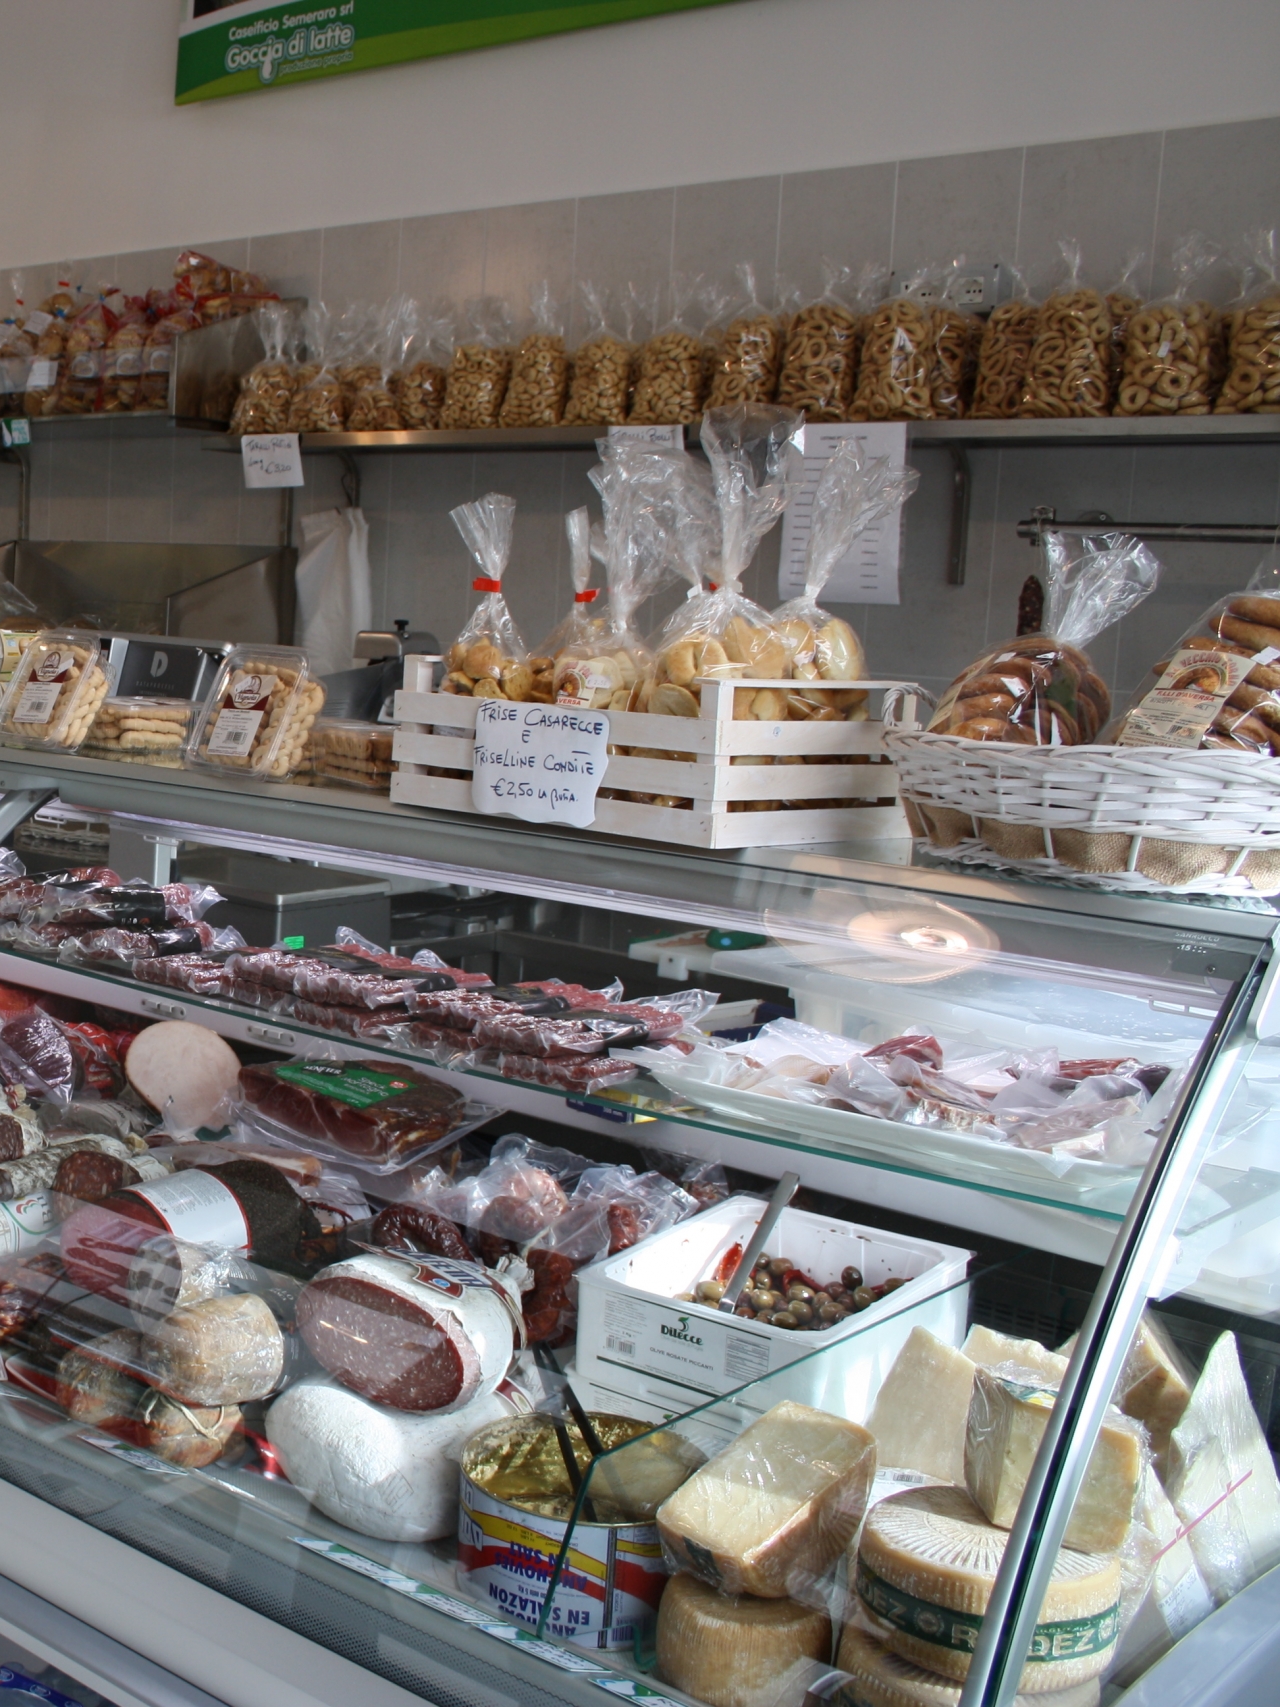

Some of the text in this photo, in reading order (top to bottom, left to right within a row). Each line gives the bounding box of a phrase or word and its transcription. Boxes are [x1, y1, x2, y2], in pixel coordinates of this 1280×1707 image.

[229, 1, 354, 41] Caseificio Semeraro srl
[227, 25, 352, 70] Goccia di latte
[480, 701, 603, 735] FRISE CASARECCE
[522, 729, 531, 743] E
[661, 1323, 704, 1346] Dilecce
[649, 1346, 714, 1371] OLIVE ROSATE PICCANTI
[509, 1541, 543, 1564] SALT
[568, 1609, 590, 1626] EN
